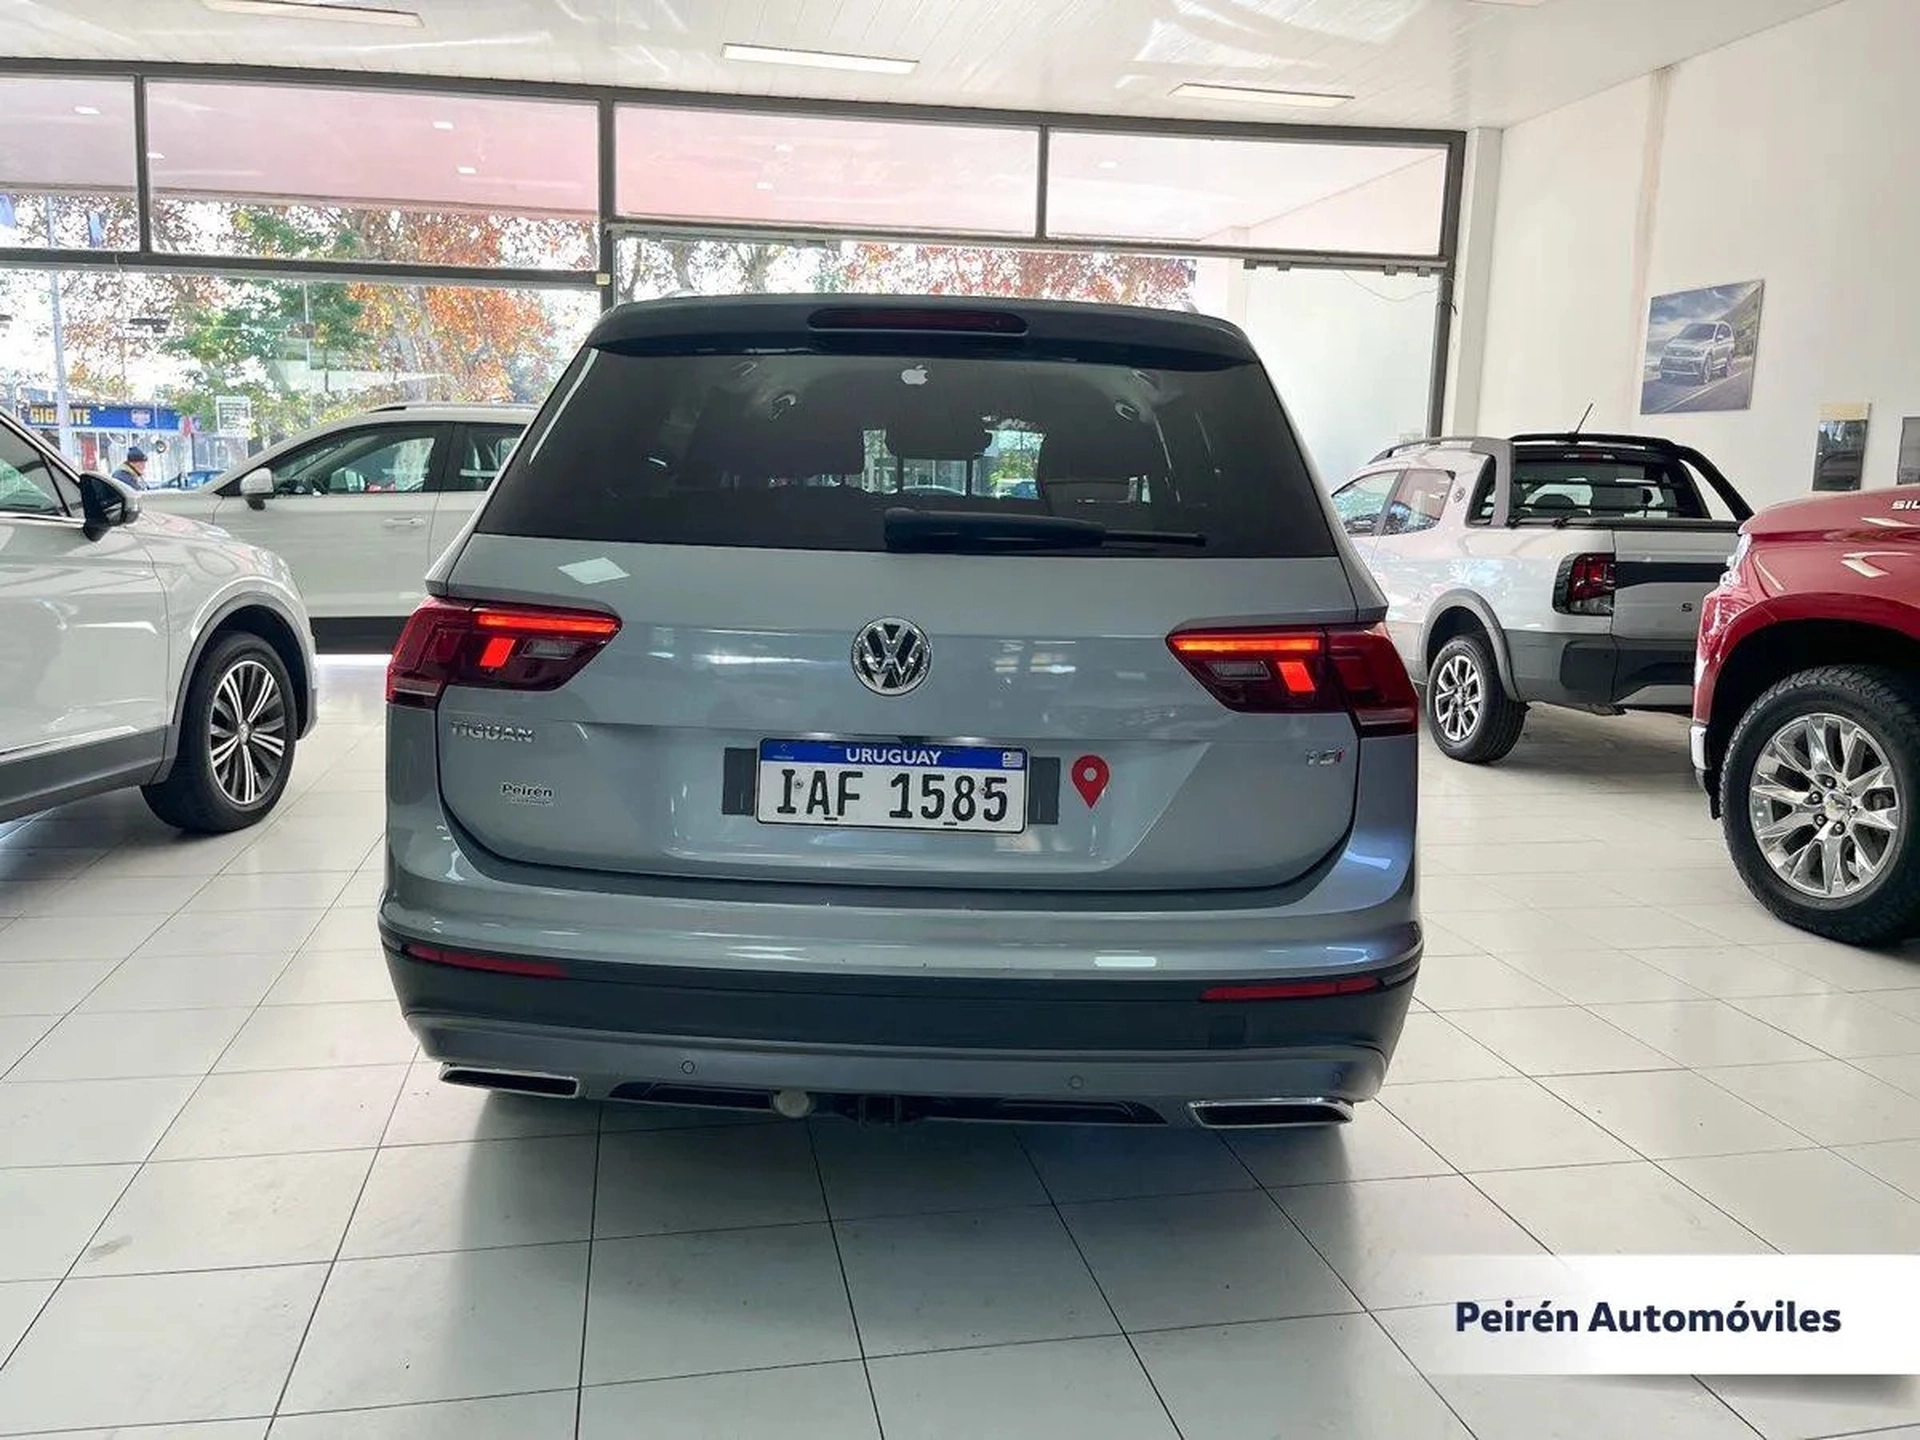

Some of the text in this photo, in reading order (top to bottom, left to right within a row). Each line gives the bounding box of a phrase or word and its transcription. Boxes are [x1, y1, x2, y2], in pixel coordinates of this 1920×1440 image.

[845, 747, 942, 765] URUGUAY
[777, 769, 1007, 822] IAF 1585
